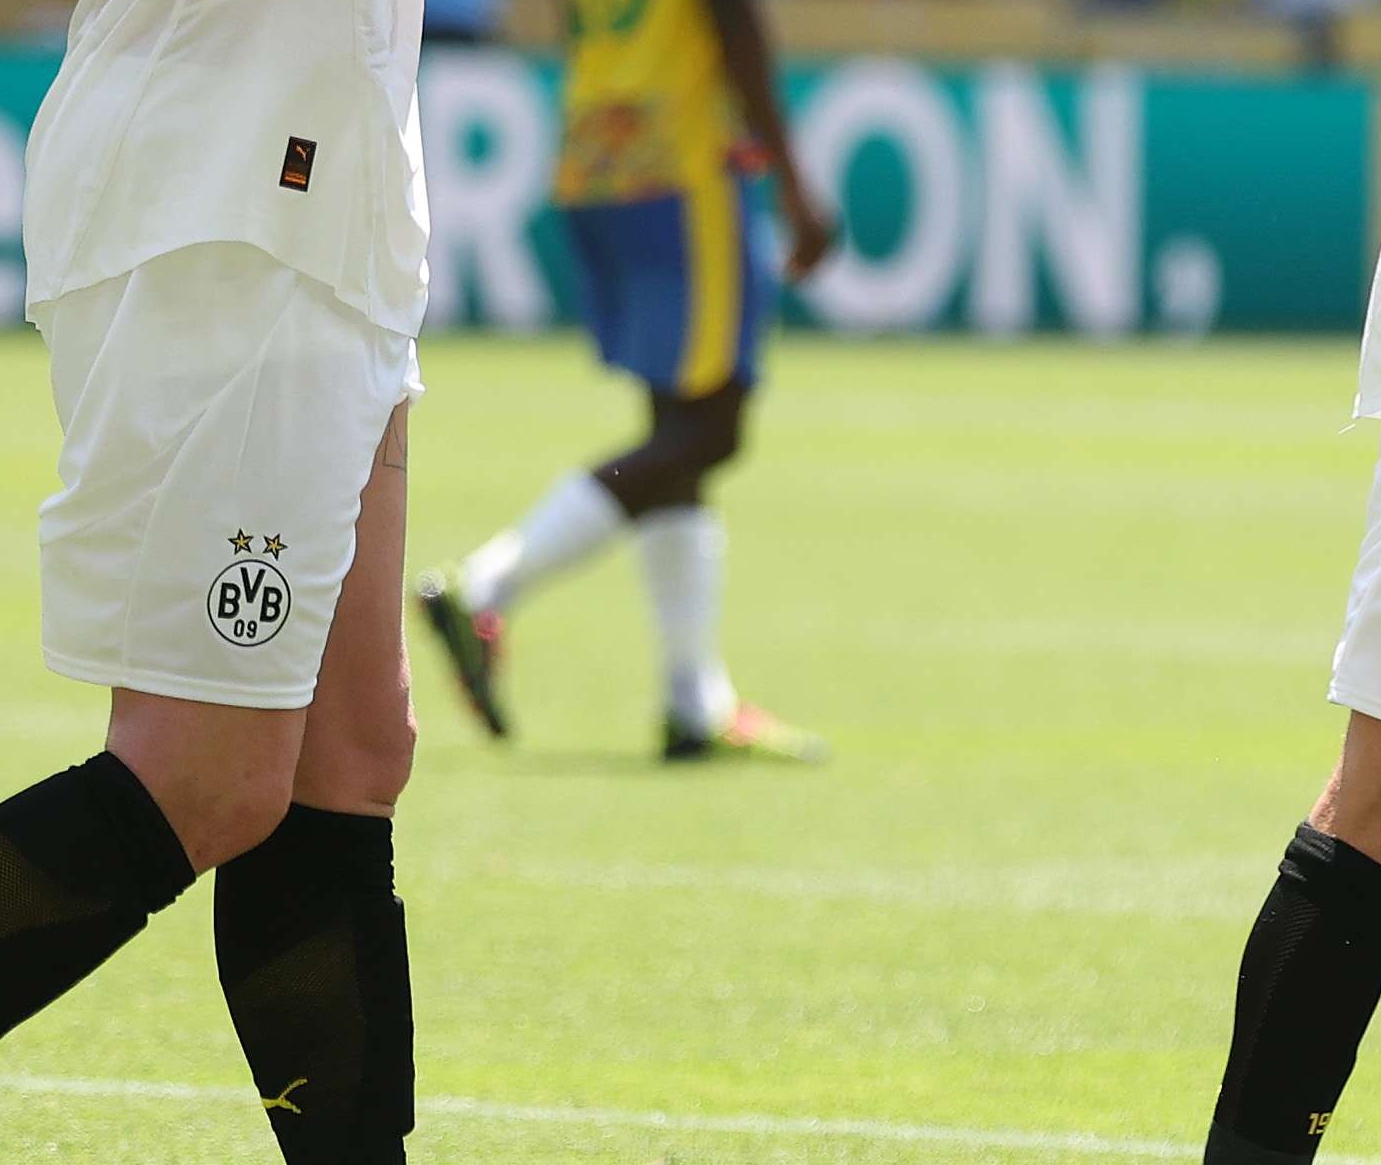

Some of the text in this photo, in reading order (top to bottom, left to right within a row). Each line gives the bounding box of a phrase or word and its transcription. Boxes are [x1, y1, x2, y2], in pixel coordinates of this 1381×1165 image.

[792, 54, 1220, 344] ON,
[217, 566, 283, 623] BVB
[233, 618, 258, 639] 09
